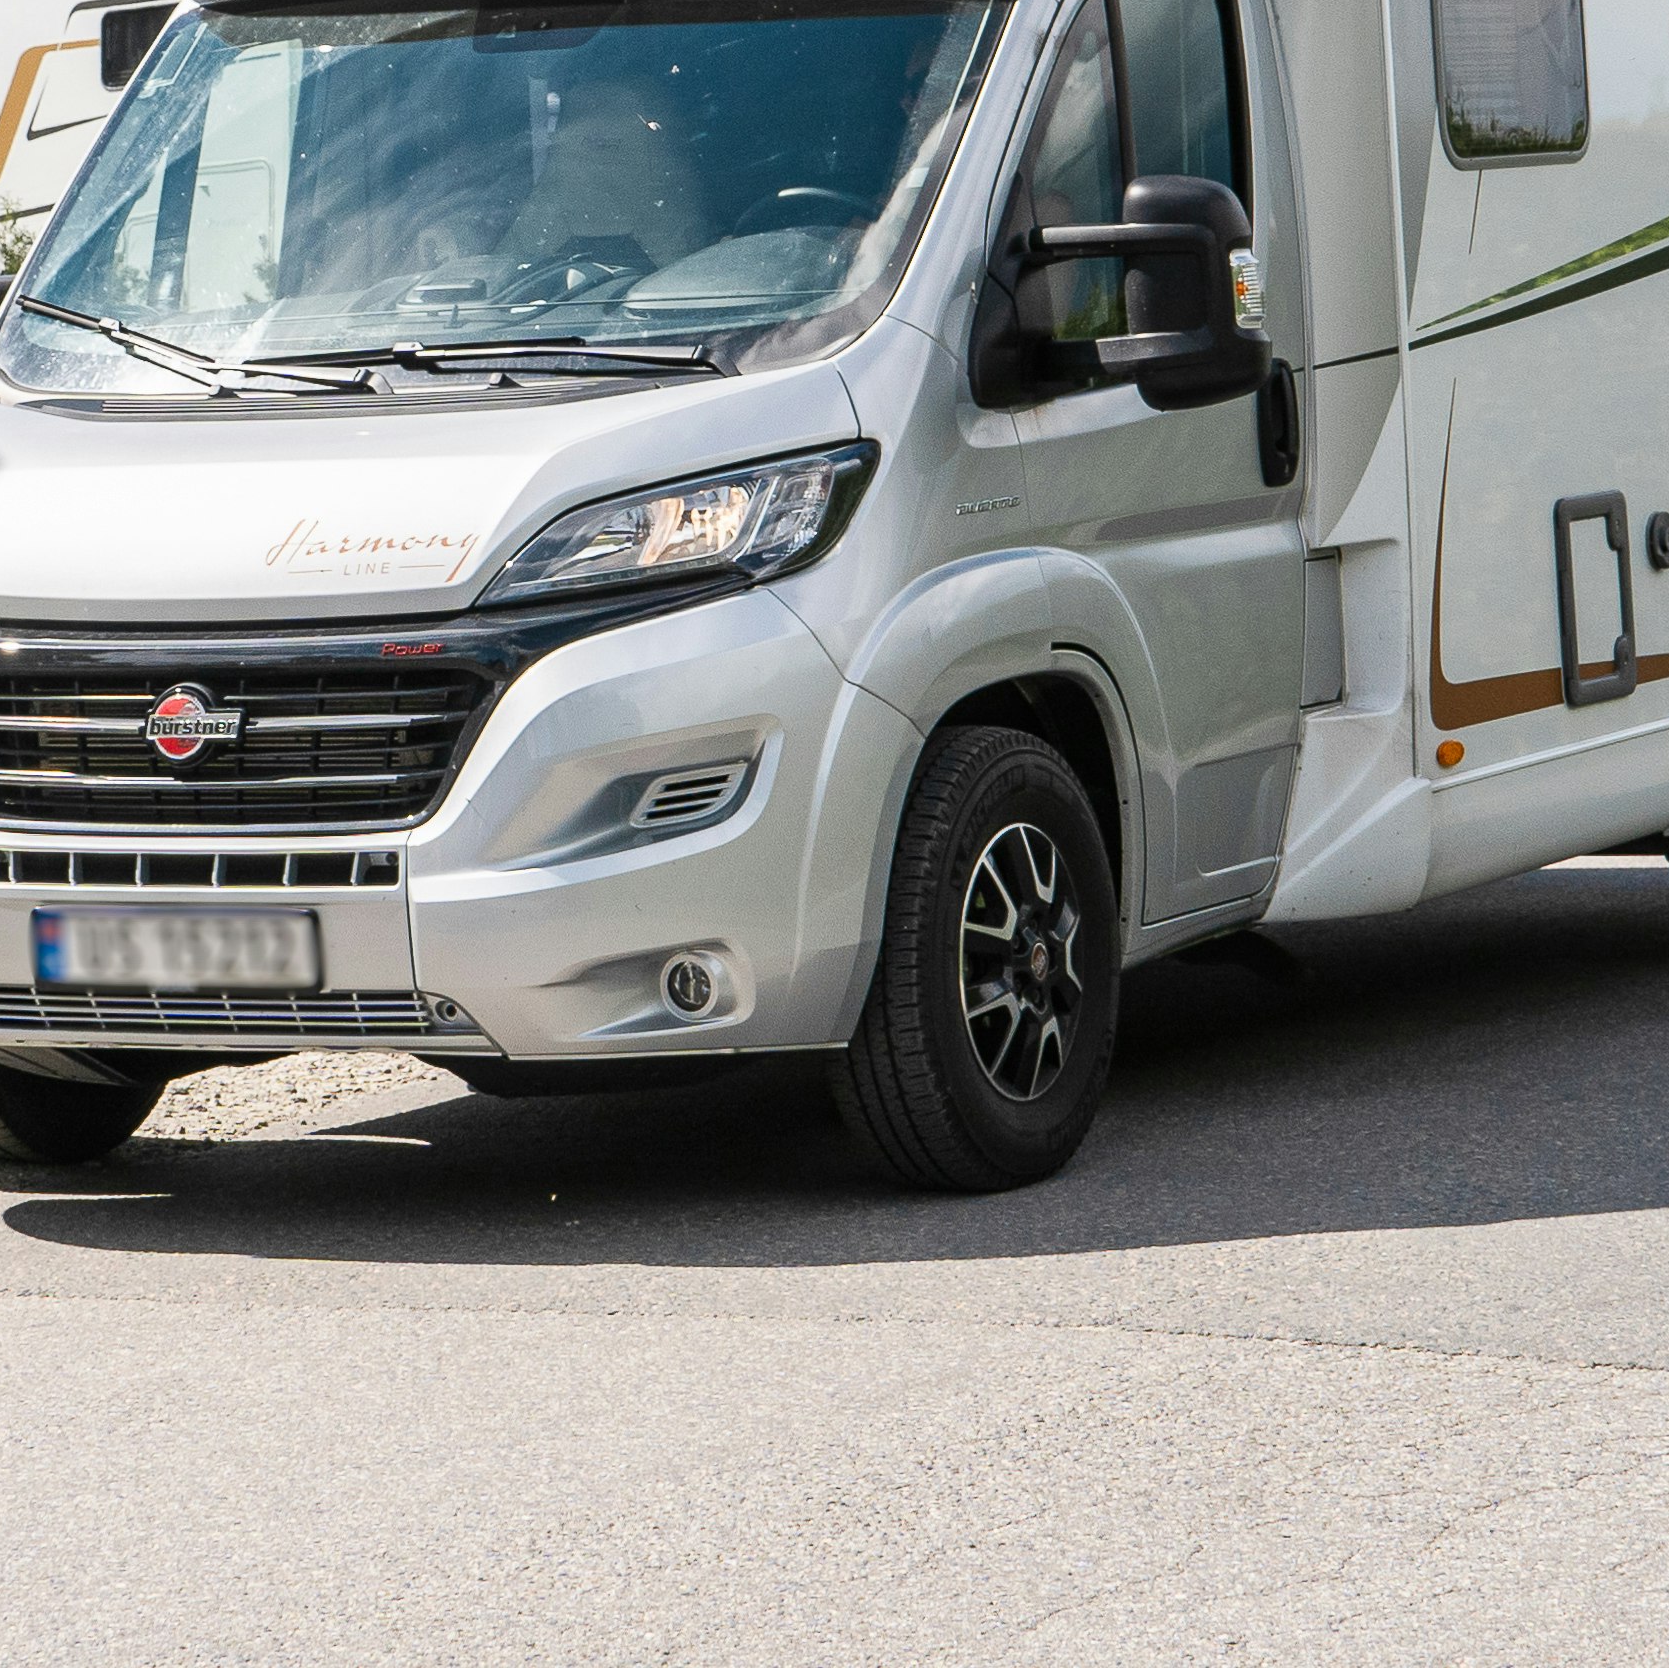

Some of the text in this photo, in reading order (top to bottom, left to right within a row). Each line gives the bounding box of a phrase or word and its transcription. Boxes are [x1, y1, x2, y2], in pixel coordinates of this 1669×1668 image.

[266, 519, 481, 583] Harmony
[343, 562, 392, 576] LINE
[381, 642, 446, 657] Power
[149, 717, 237, 735] bürstner
